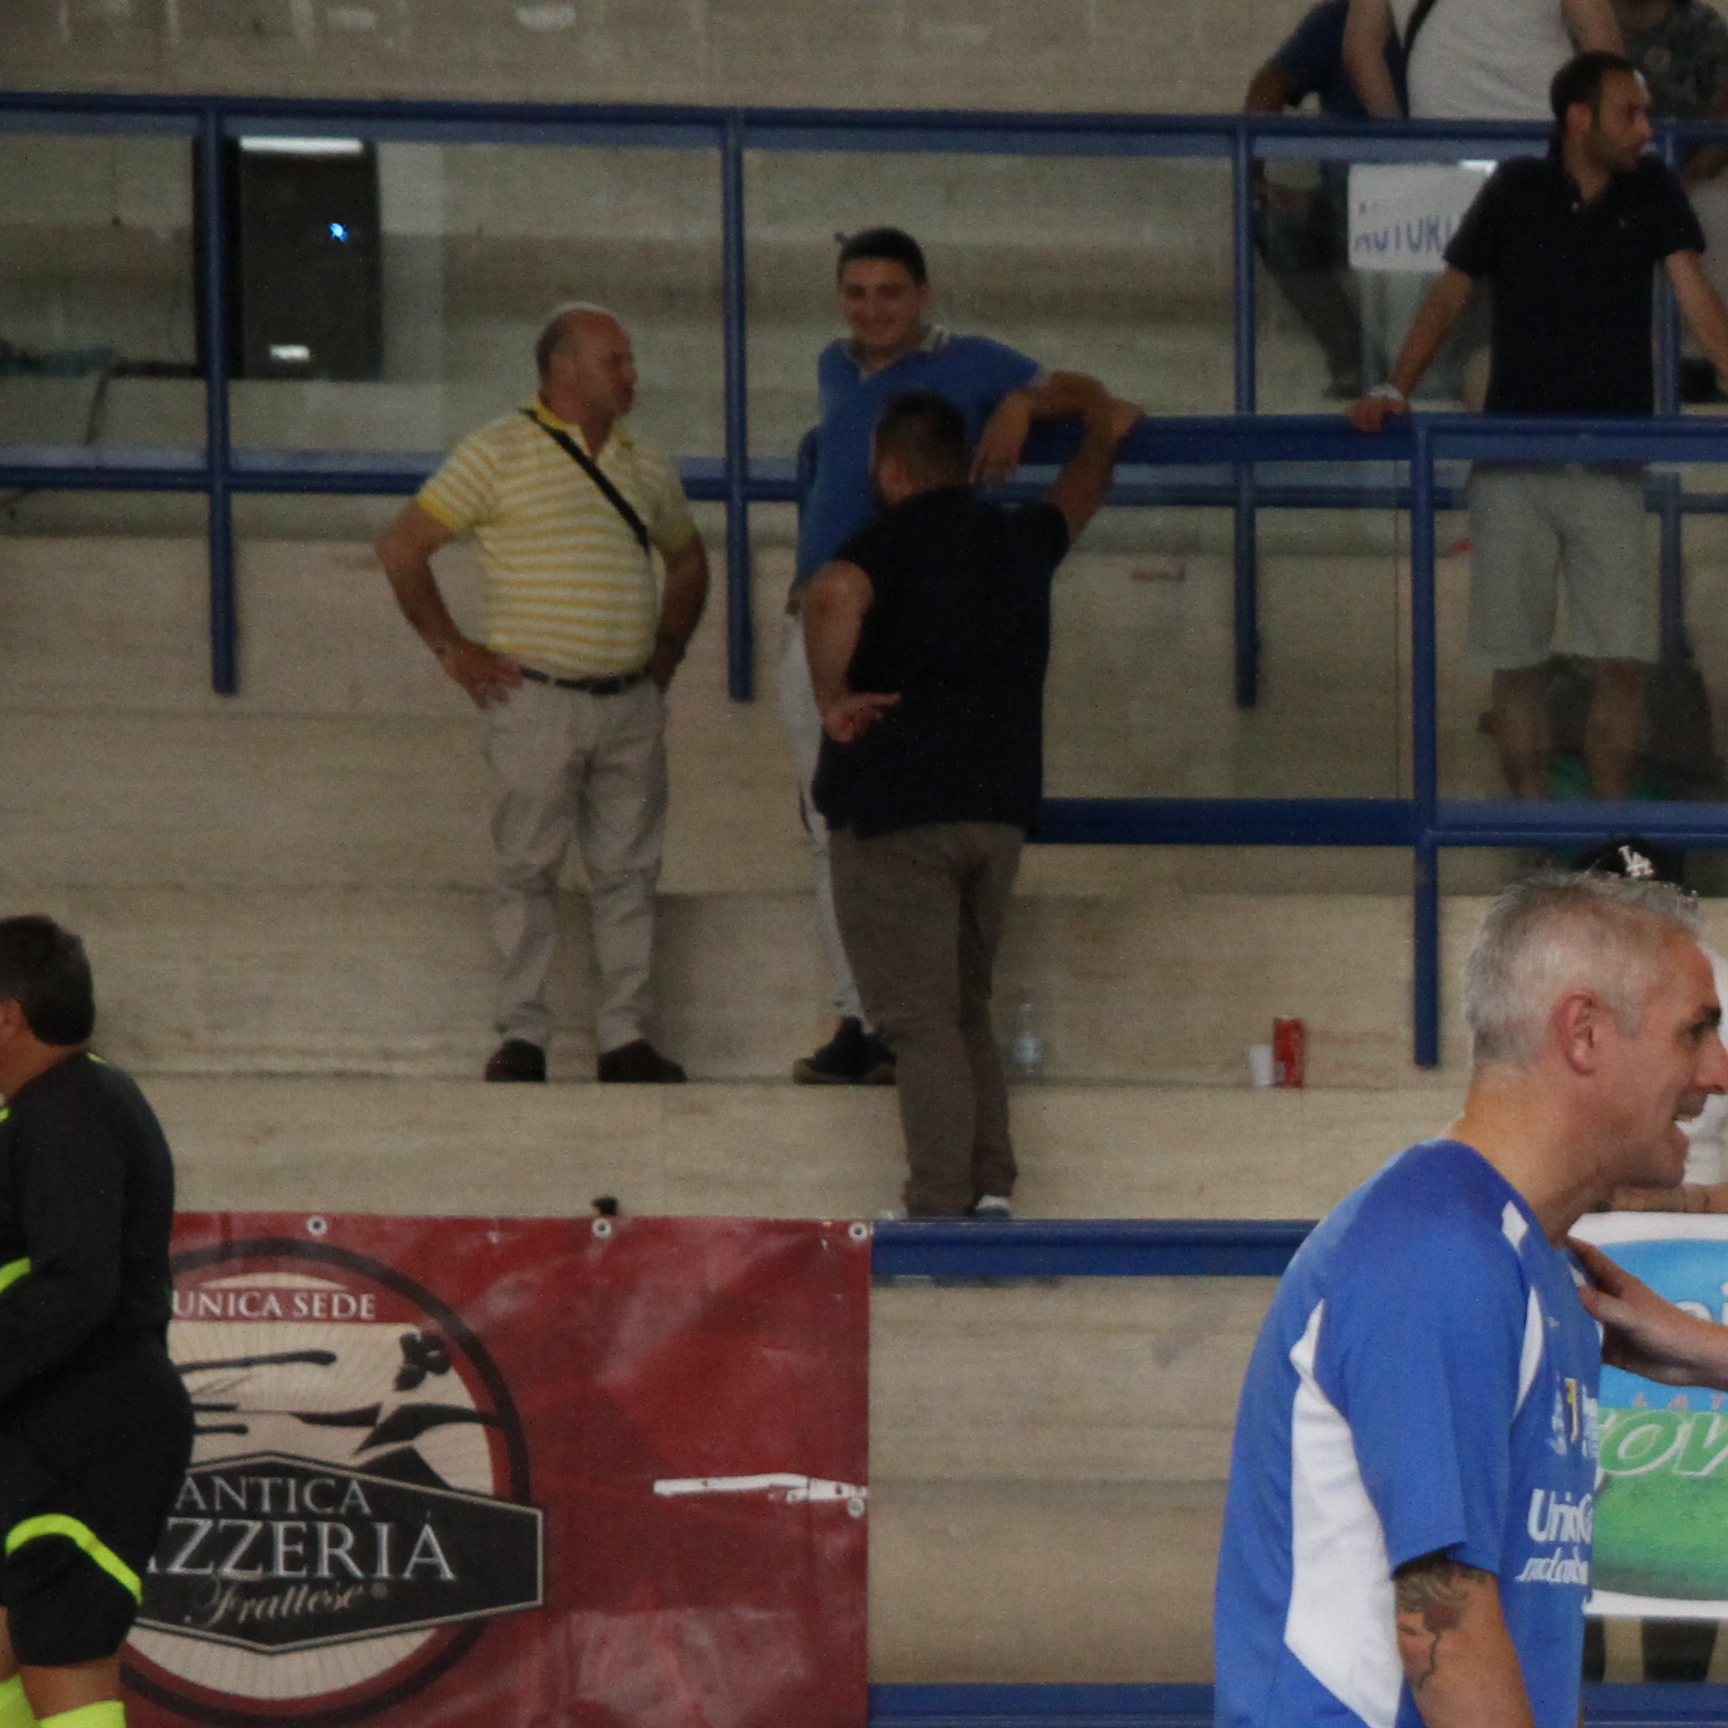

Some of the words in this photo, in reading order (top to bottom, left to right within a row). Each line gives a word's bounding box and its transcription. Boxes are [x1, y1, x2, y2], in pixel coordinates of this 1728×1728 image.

[172, 1291, 282, 1318] UNICA
[294, 1293, 375, 1319] SEDE
[175, 1475, 372, 1515] ANTICA
[147, 1515, 457, 1582] ZZERIA
